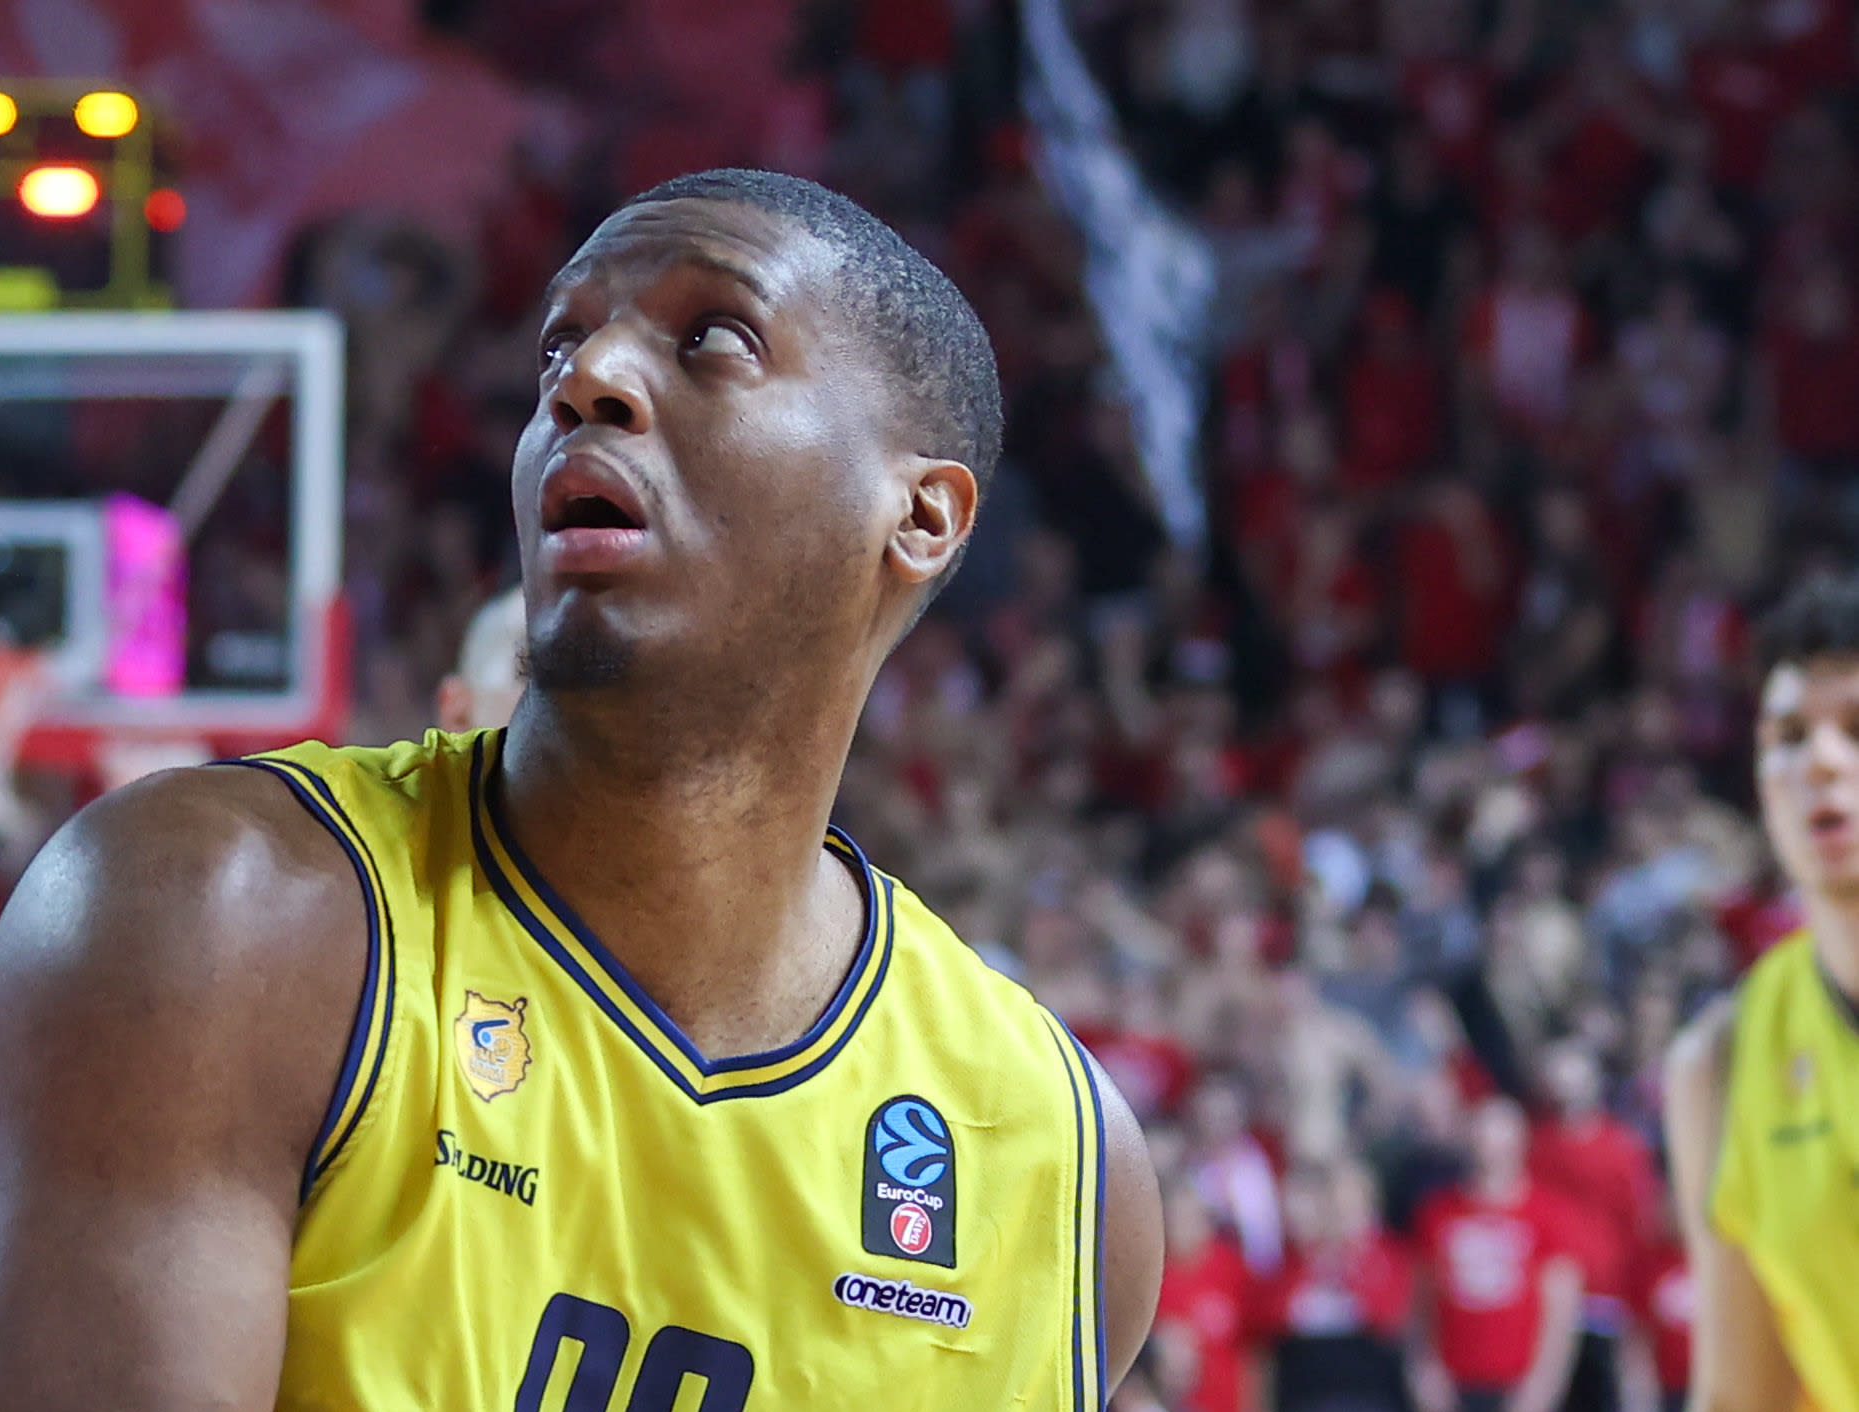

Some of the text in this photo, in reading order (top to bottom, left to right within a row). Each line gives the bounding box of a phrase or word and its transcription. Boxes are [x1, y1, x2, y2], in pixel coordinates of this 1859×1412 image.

[877, 1182, 943, 1210] EuroCup
[899, 1209, 920, 1245] 7
[846, 1277, 967, 1323] oneteam
